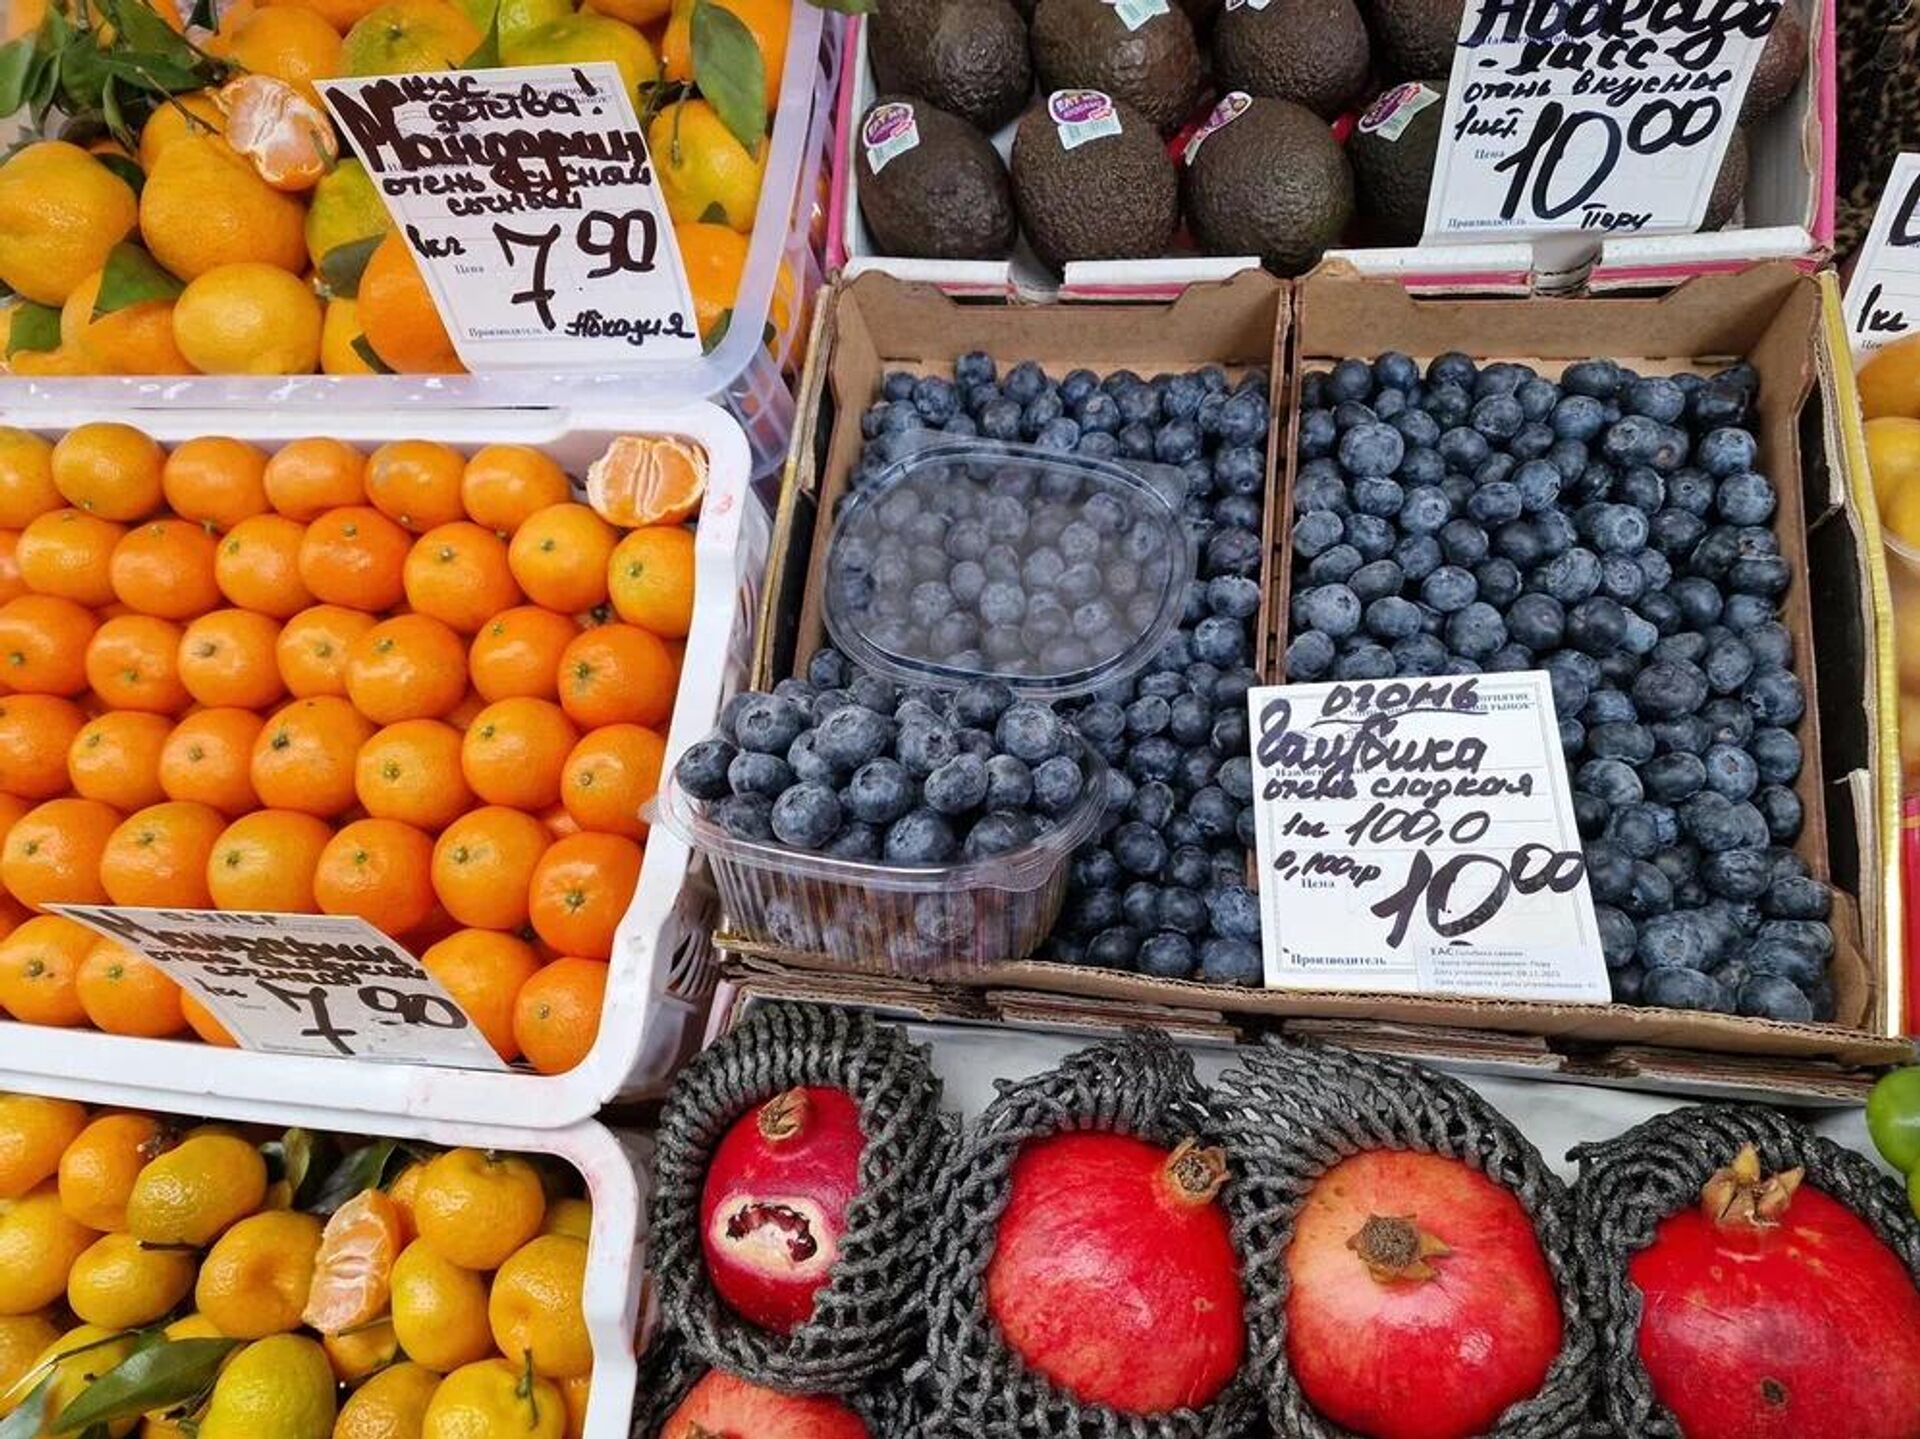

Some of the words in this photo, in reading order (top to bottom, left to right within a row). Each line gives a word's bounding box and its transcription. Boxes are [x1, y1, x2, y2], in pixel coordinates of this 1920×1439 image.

[492, 223, 562, 331] 7
[576, 210, 658, 279] 90
[1289, 952, 1388, 967] Производитель
